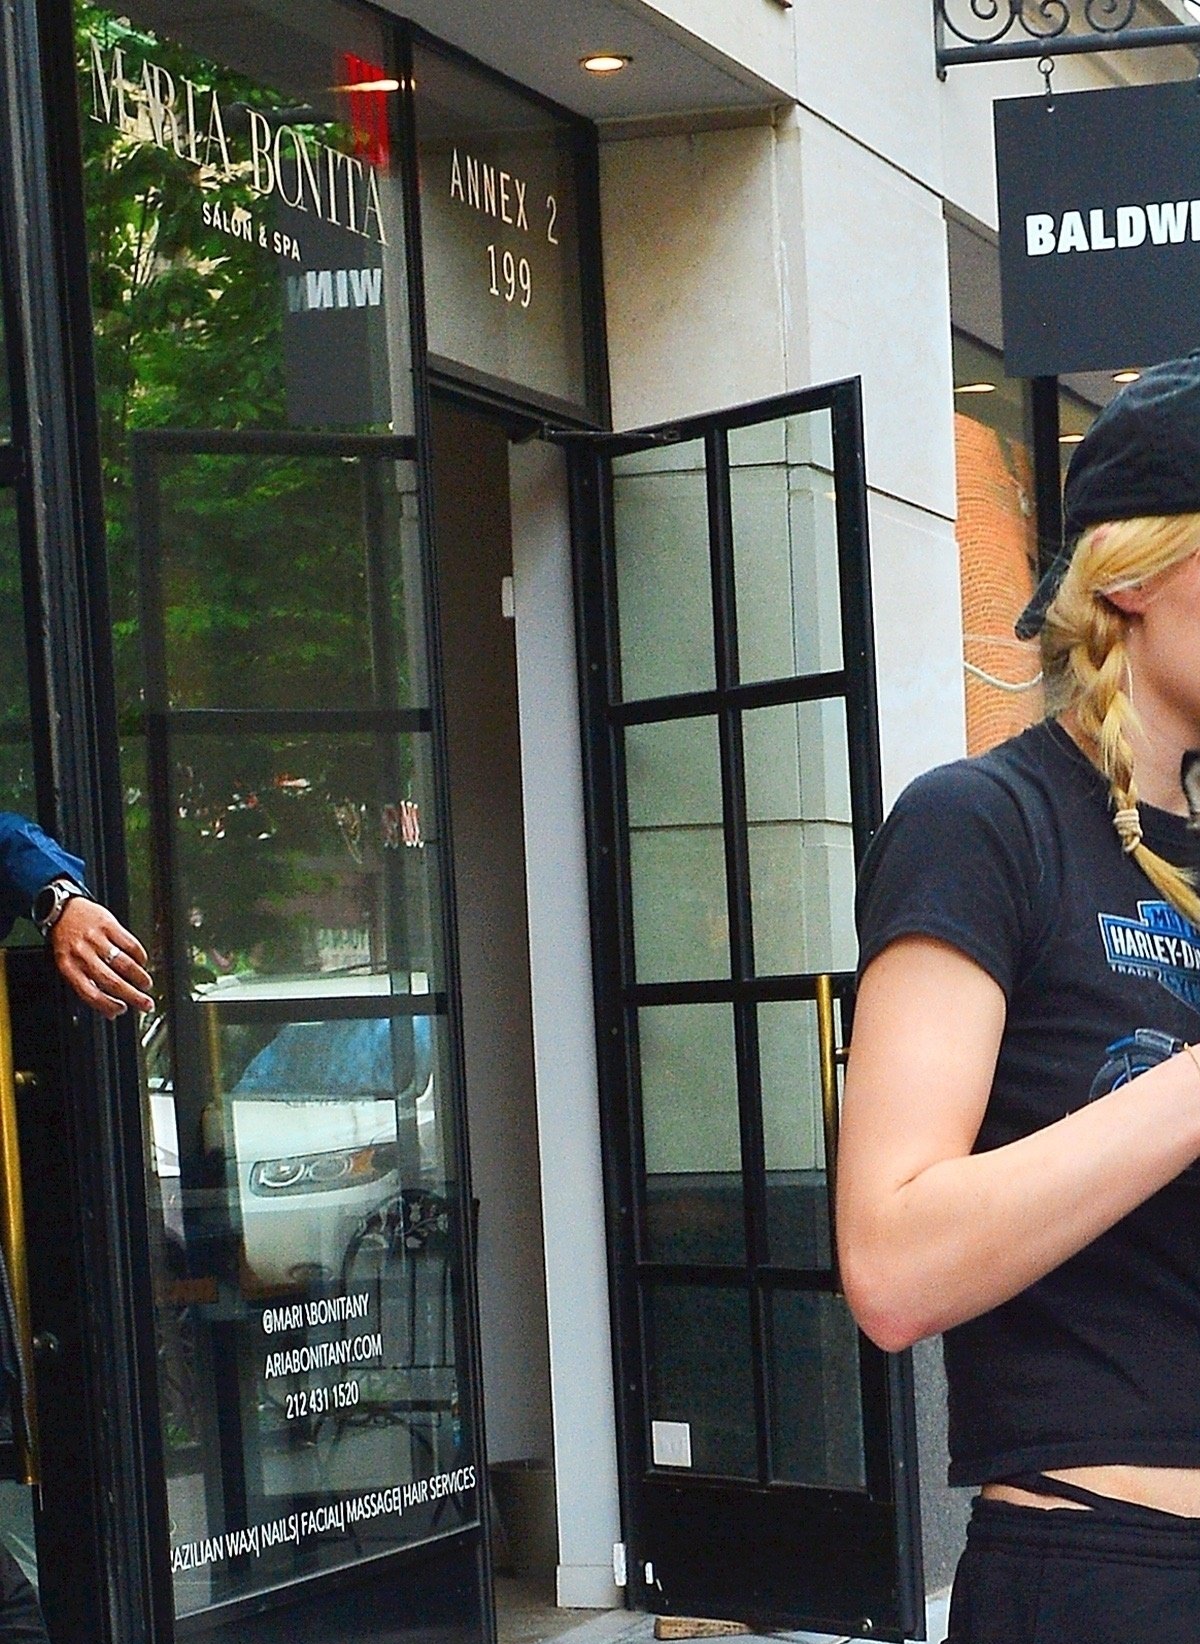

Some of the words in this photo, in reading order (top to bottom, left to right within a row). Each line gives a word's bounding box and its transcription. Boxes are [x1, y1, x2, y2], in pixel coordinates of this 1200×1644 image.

[89, 33, 237, 182] MARIA
[246, 109, 389, 246] BONITA
[451, 148, 528, 231] ANNEX
[546, 195, 559, 245] 2
[203, 205, 252, 243] SALON
[259, 226, 267, 249] &
[274, 232, 301, 262] SPA
[487, 245, 531, 308] 199
[285, 1391, 308, 1420] 212
[309, 1387, 329, 1413] 431
[332, 1380, 359, 1408] 1520
[403, 1480, 428, 1507] HAIR
[429, 1465, 476, 1500] SERVICES
